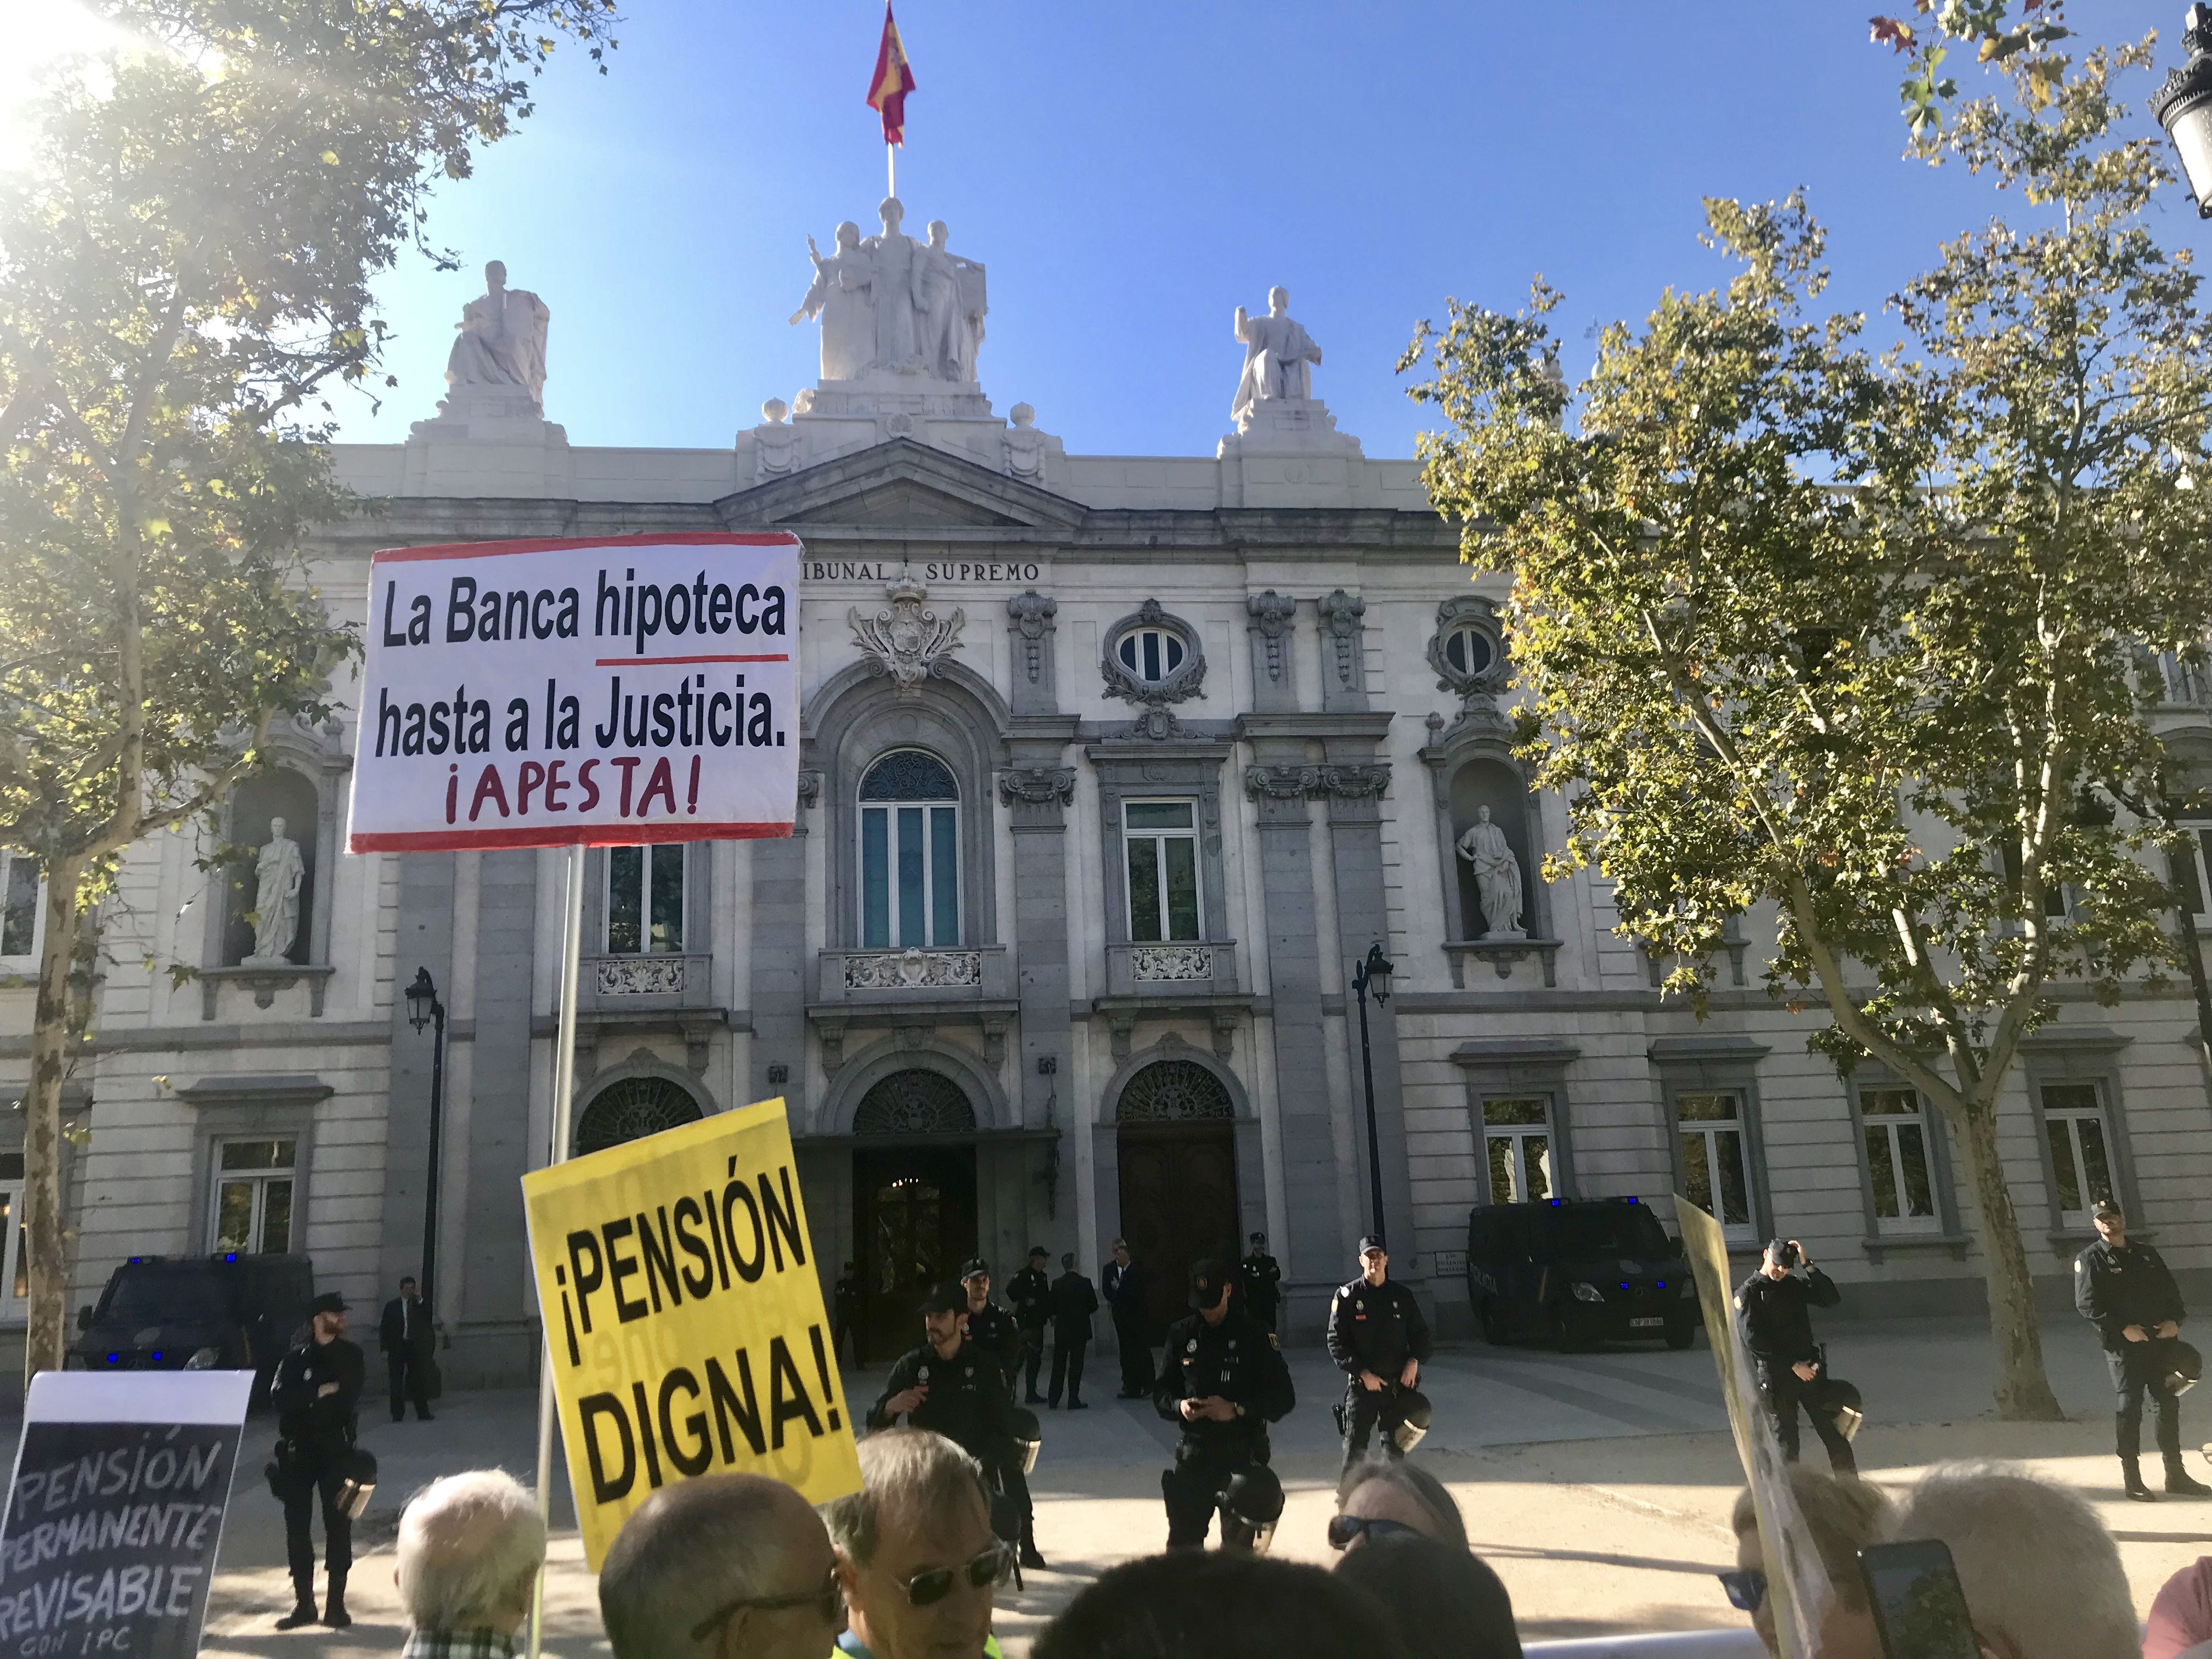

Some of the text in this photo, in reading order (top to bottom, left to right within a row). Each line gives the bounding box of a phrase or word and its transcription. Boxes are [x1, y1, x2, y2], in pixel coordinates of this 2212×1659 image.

[382, 568, 786, 654] La Banca hipoteca
[803, 562, 1039, 581] IBUNAL SUPREMO
[375, 674, 786, 758] hasta a la Justicia.
[445, 754, 702, 825] ¡APESTA!
[556, 1154, 806, 1368] ¡PENSIÓN
[578, 1324, 842, 1505] DIGNA!
[0, 1502, 222, 1586] PERMANENTE
